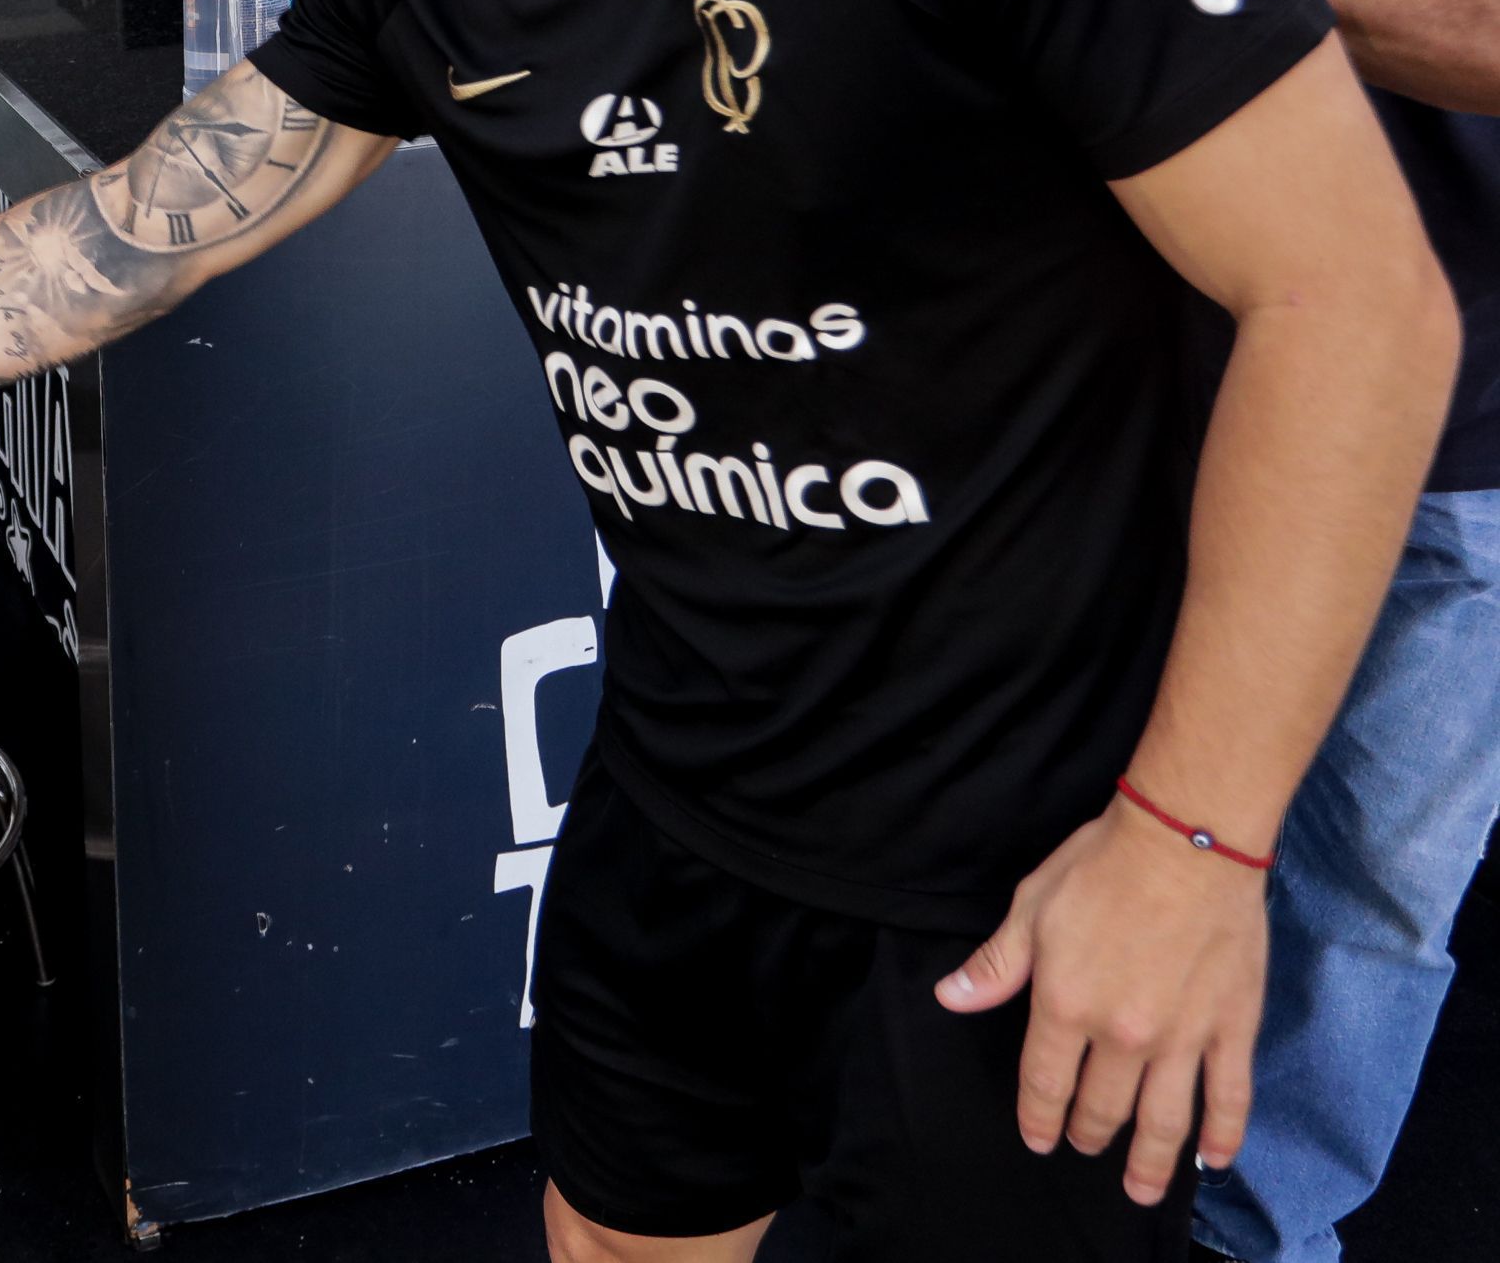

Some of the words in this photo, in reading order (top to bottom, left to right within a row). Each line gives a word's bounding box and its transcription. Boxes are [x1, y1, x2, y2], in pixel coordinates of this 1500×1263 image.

[587, 144, 680, 178] ALE
[526, 282, 867, 363] vitaminas
[543, 350, 697, 433] neo
[569, 434, 932, 531] química
